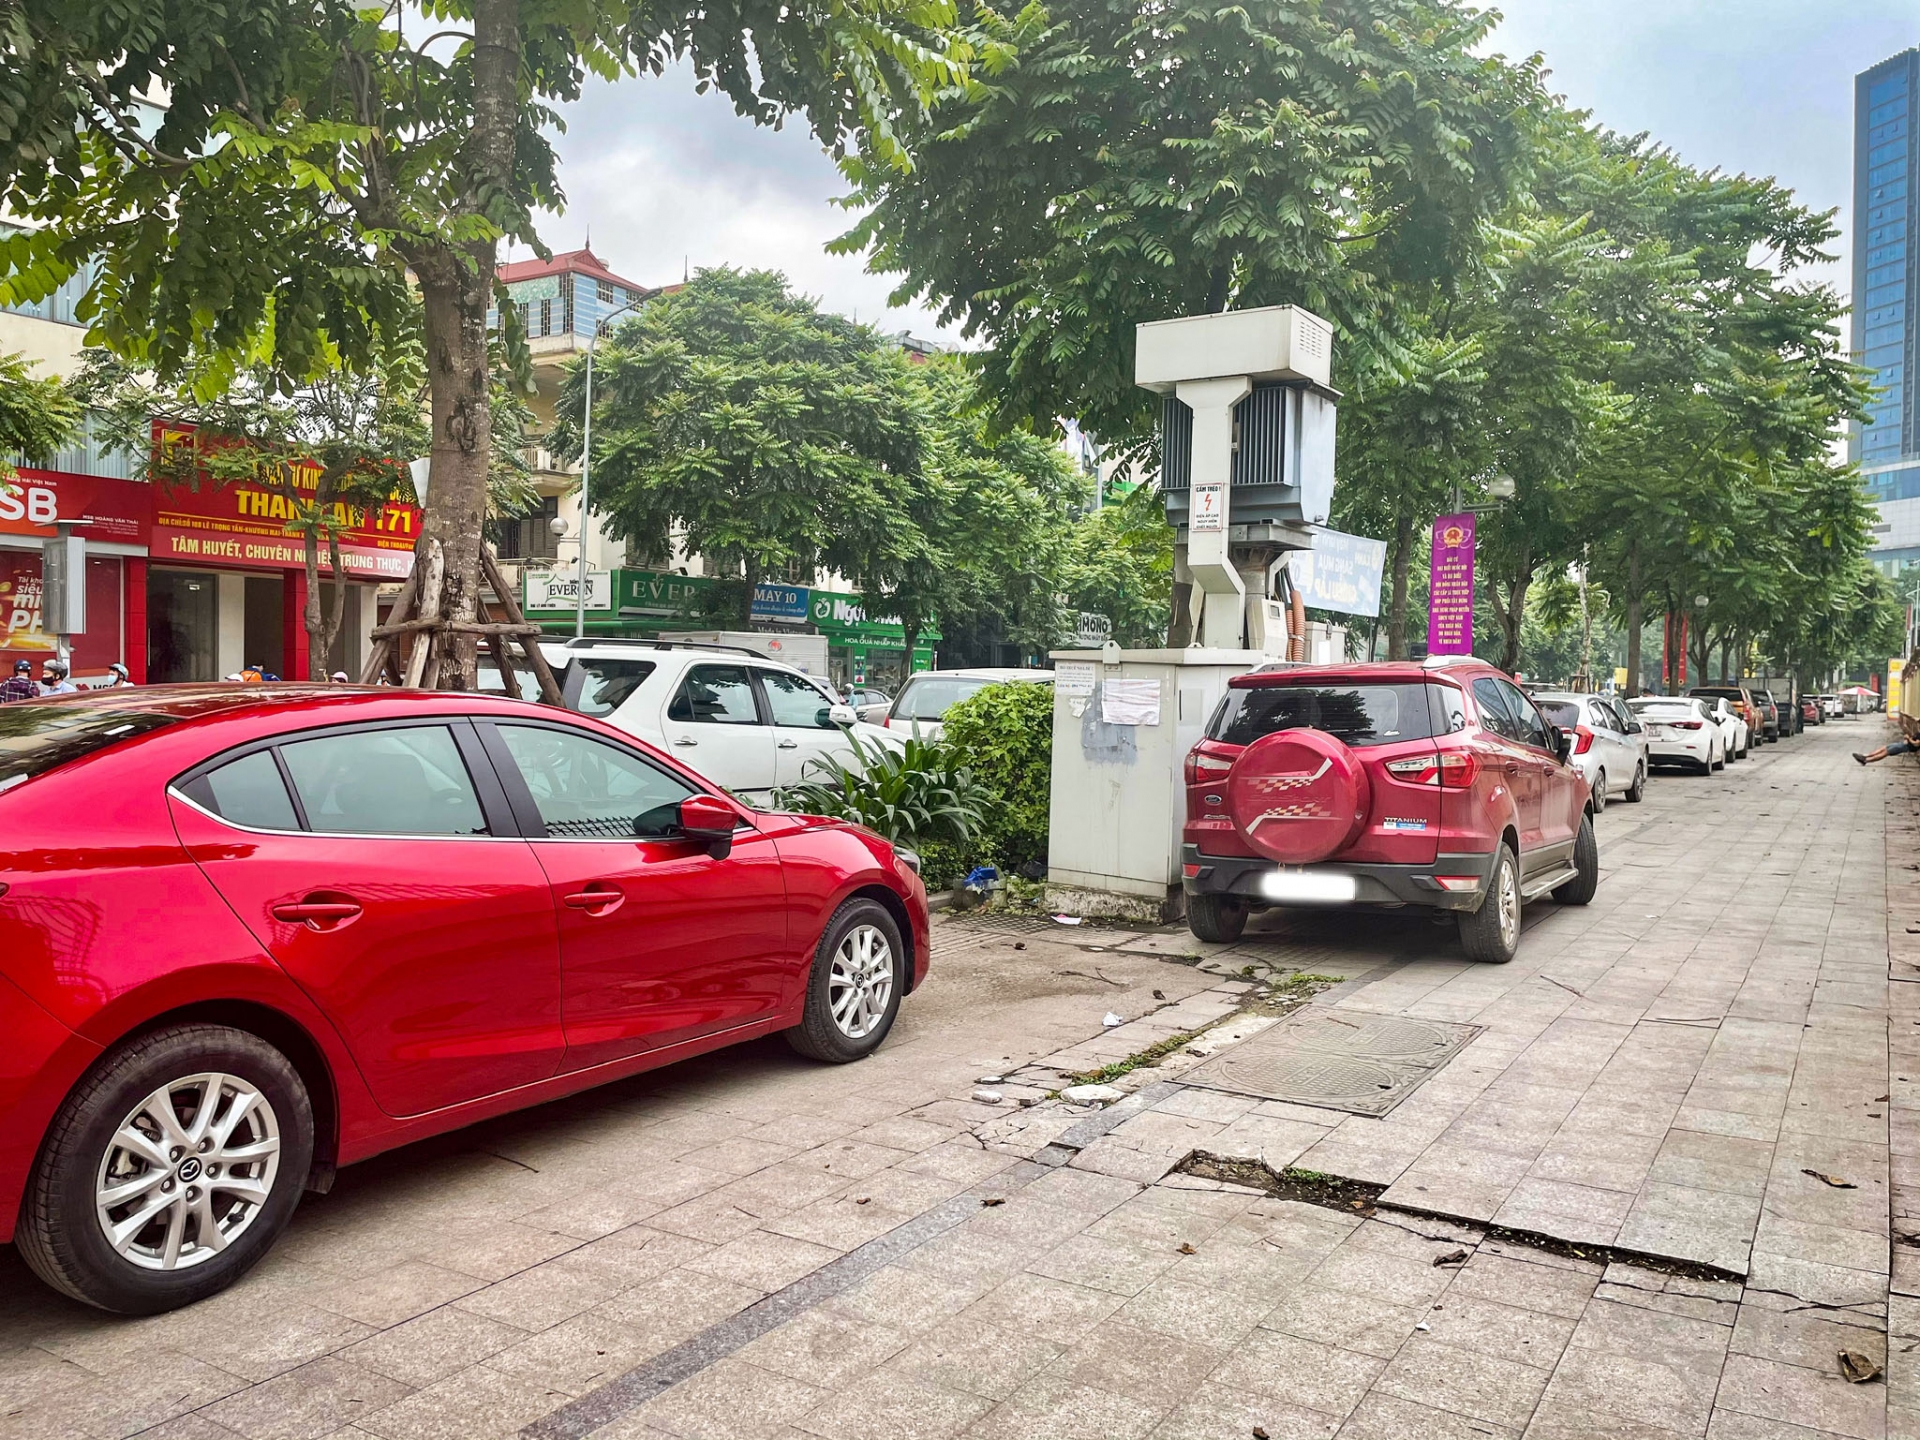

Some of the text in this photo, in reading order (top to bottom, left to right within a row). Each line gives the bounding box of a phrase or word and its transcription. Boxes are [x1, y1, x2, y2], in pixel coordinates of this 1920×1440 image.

[171, 535, 199, 553] TÂM
[202, 539, 242, 558] HUYẾT,
[245, 544, 292, 562] CHUYÊN
[753, 588, 797, 604] MAY 10
[1384, 816, 1428, 824] TITANIUM
